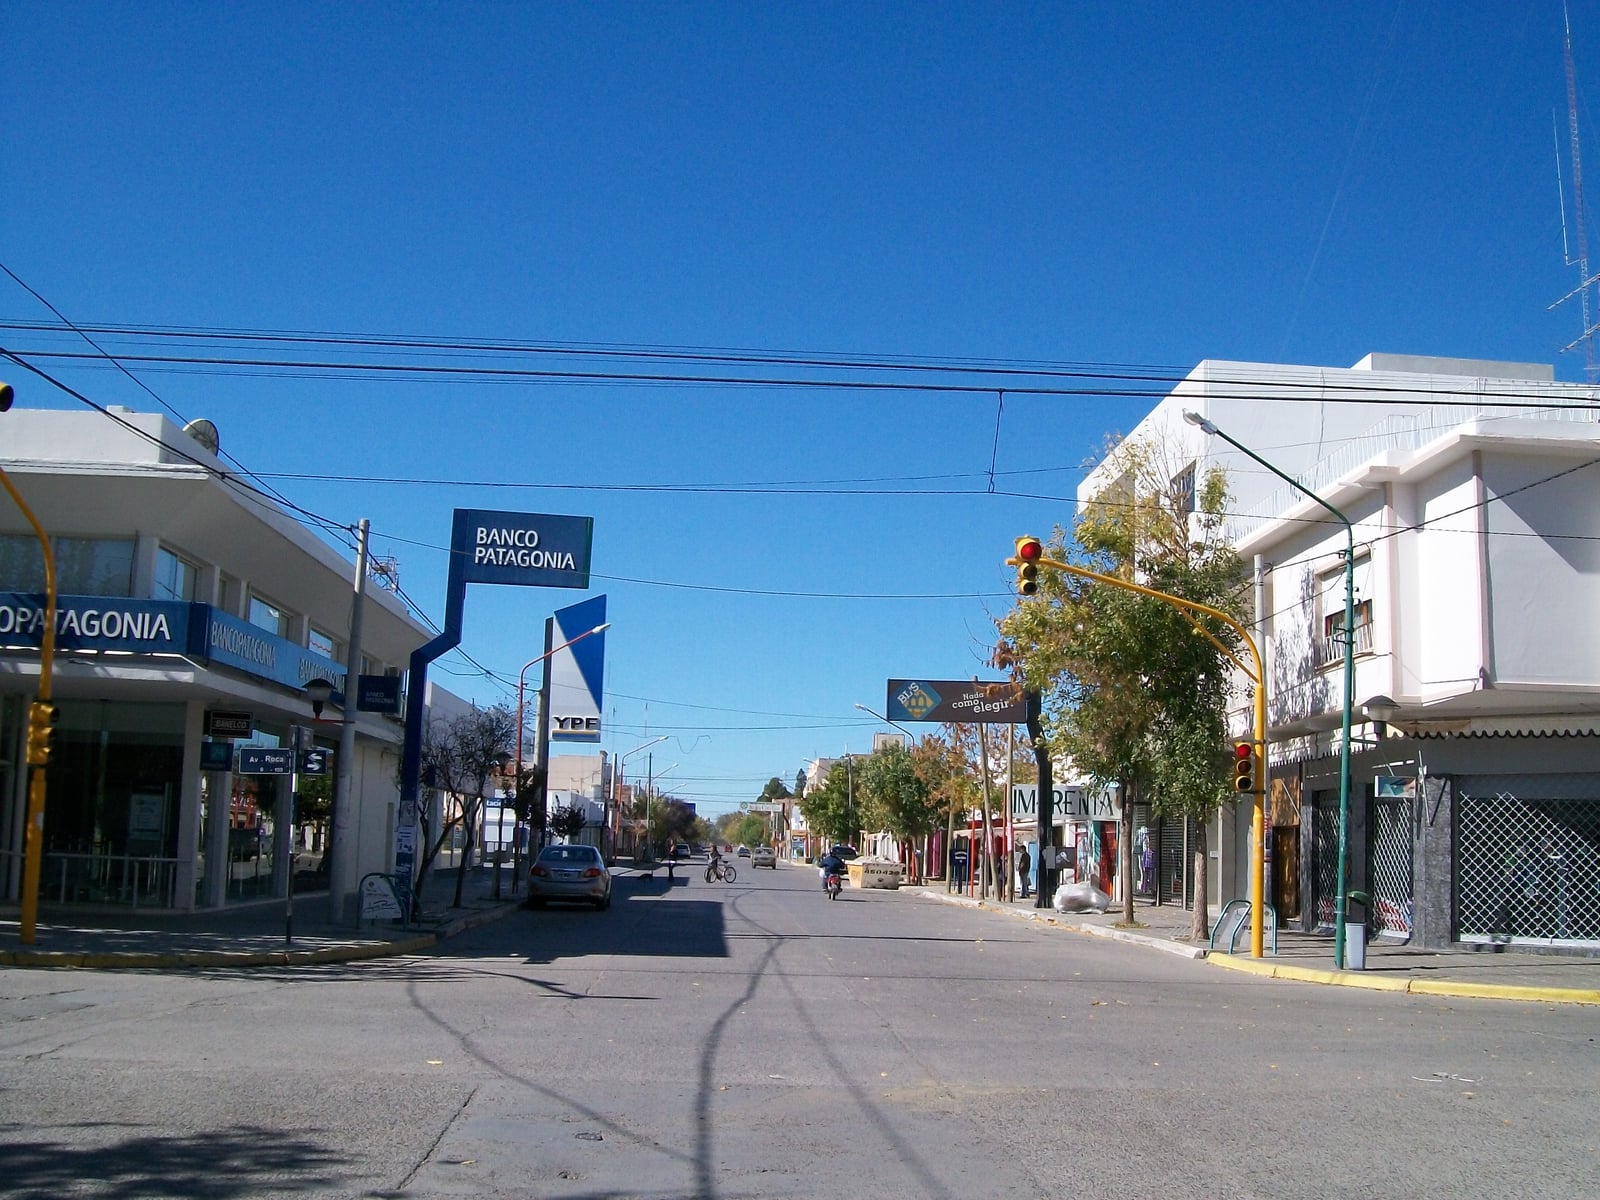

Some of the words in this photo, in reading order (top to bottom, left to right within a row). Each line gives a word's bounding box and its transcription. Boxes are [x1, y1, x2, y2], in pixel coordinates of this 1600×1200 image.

[476, 527, 538, 547] BANCO
[475, 547, 575, 570] PATAGONIA
[211, 621, 276, 667] BANCOPATAGONIA
[963, 691, 984, 700] Nada
[952, 699, 980, 709] como
[552, 716, 600, 729] YPF
[265, 755, 284, 763] Roca
[1013, 789, 1113, 816] IMRENTA
